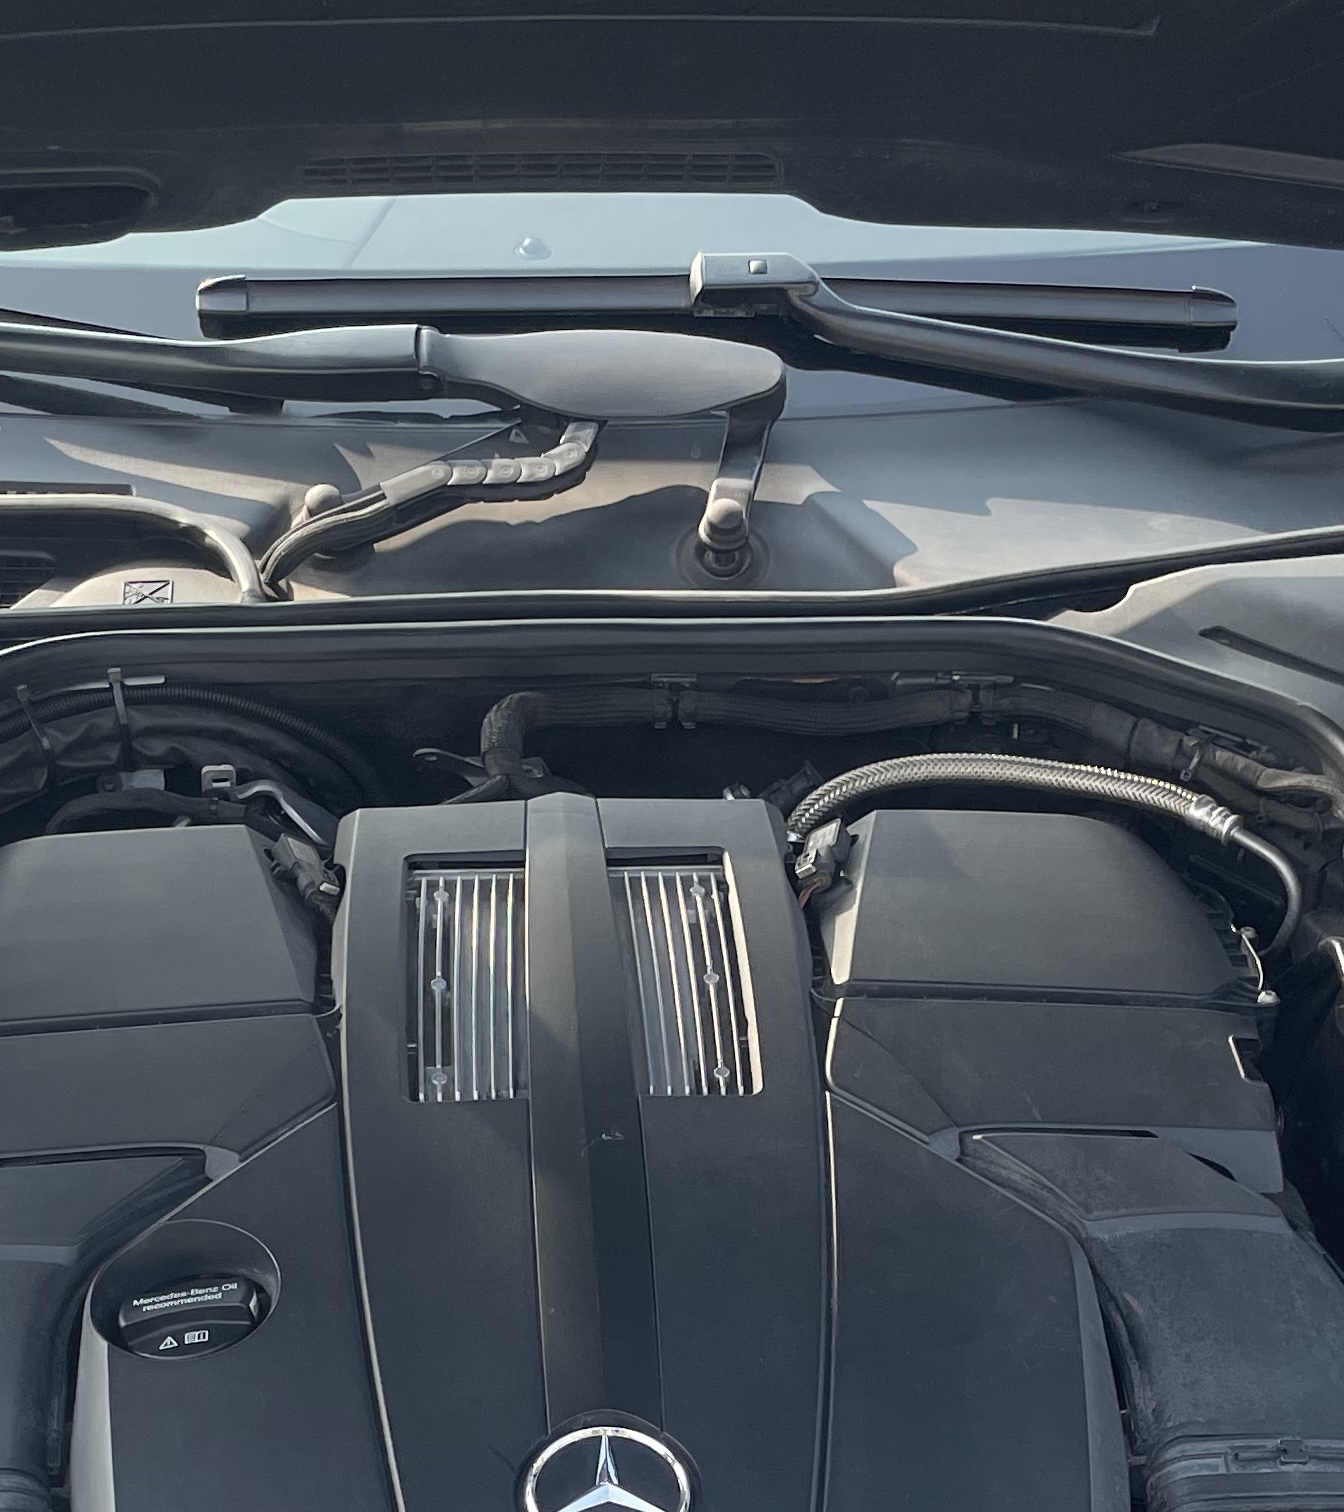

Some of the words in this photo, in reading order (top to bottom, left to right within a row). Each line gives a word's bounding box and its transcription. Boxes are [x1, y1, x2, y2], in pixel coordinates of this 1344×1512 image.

[132, 1286, 219, 1307] Mercedes-Benz
[221, 1282, 238, 1291] Oil
[142, 1292, 223, 1312] recommended
